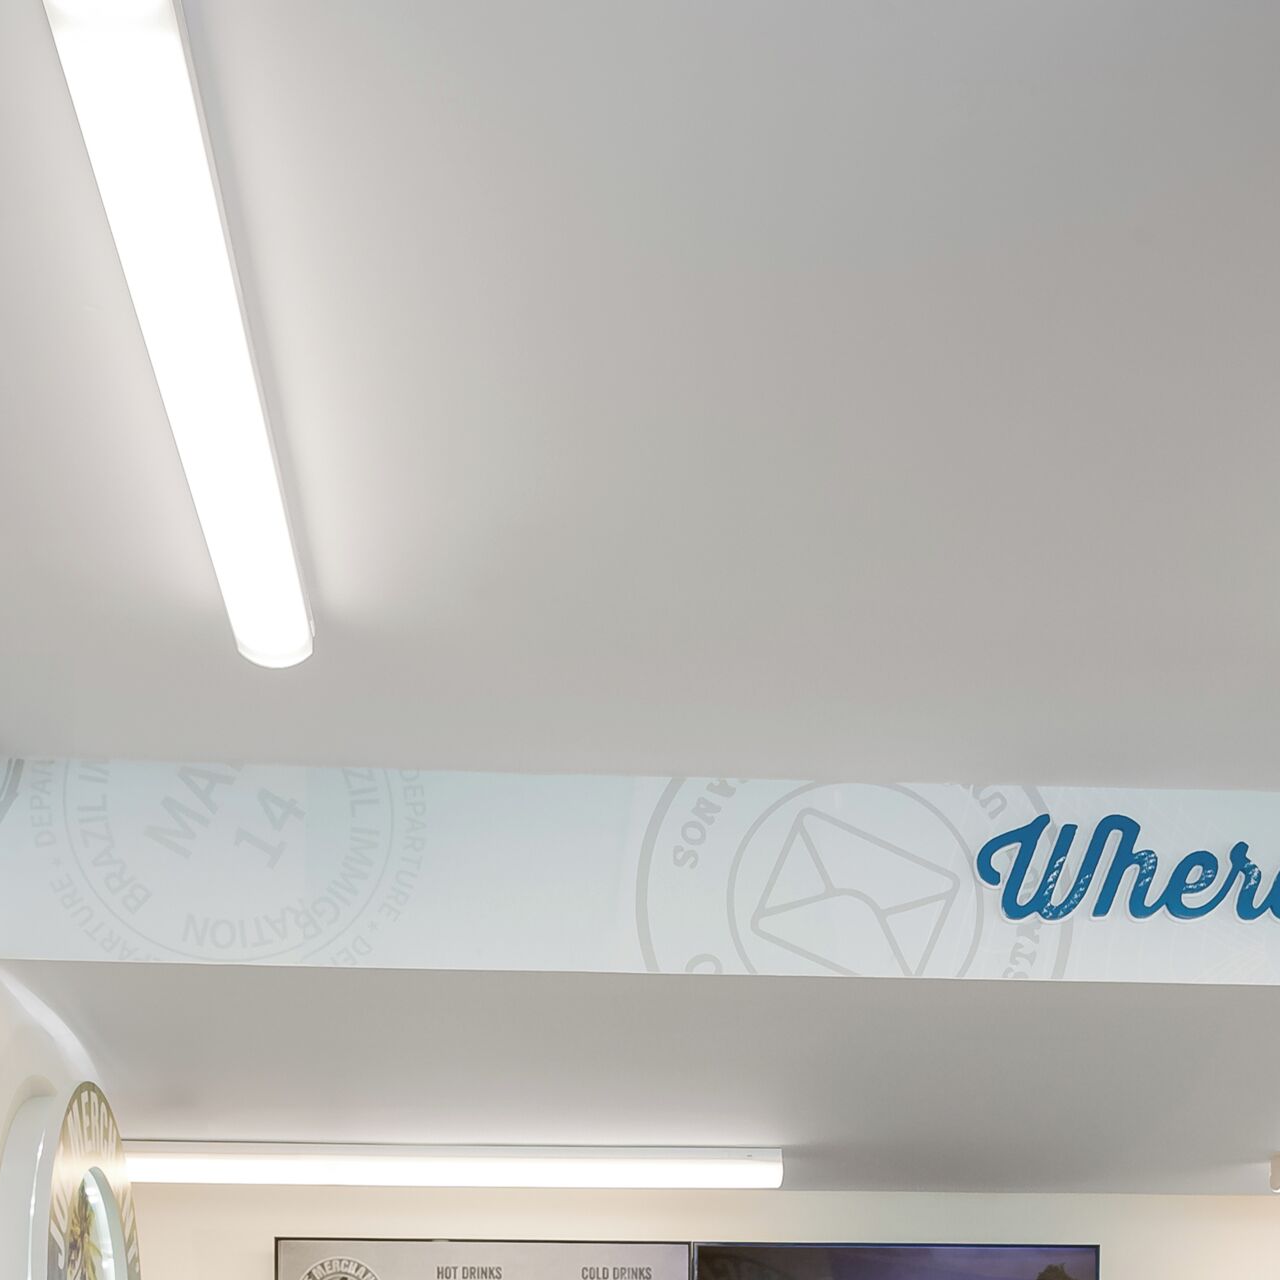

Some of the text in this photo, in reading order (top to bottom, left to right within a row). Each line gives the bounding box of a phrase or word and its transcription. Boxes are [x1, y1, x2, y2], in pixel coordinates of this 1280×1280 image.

[76, 792, 153, 915] BRAZIL
[436, 1266, 502, 1280] HOT DRINKS
[581, 1266, 652, 1280] COLD DRINKS
